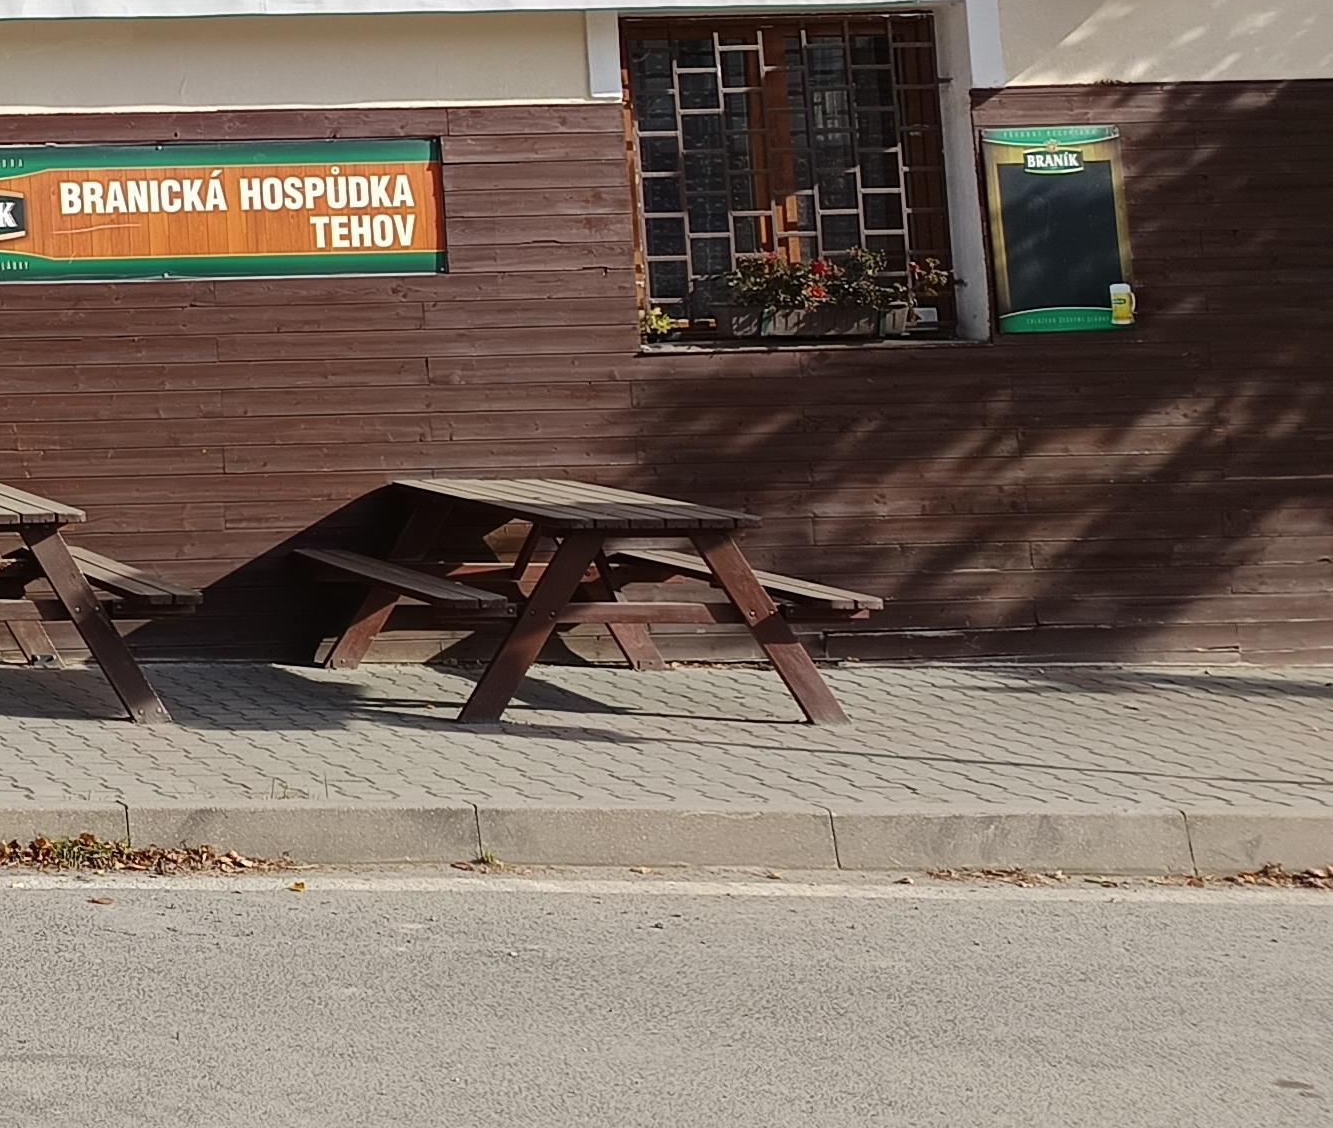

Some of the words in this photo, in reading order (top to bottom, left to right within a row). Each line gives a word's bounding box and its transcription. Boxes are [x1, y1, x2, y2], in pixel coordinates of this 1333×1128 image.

[1026, 151, 1079, 168] BRANÍK
[59, 169, 227, 215] BRANICKÁ
[239, 165, 416, 210] HOSPŮDKA
[309, 214, 416, 250] TEHOV
